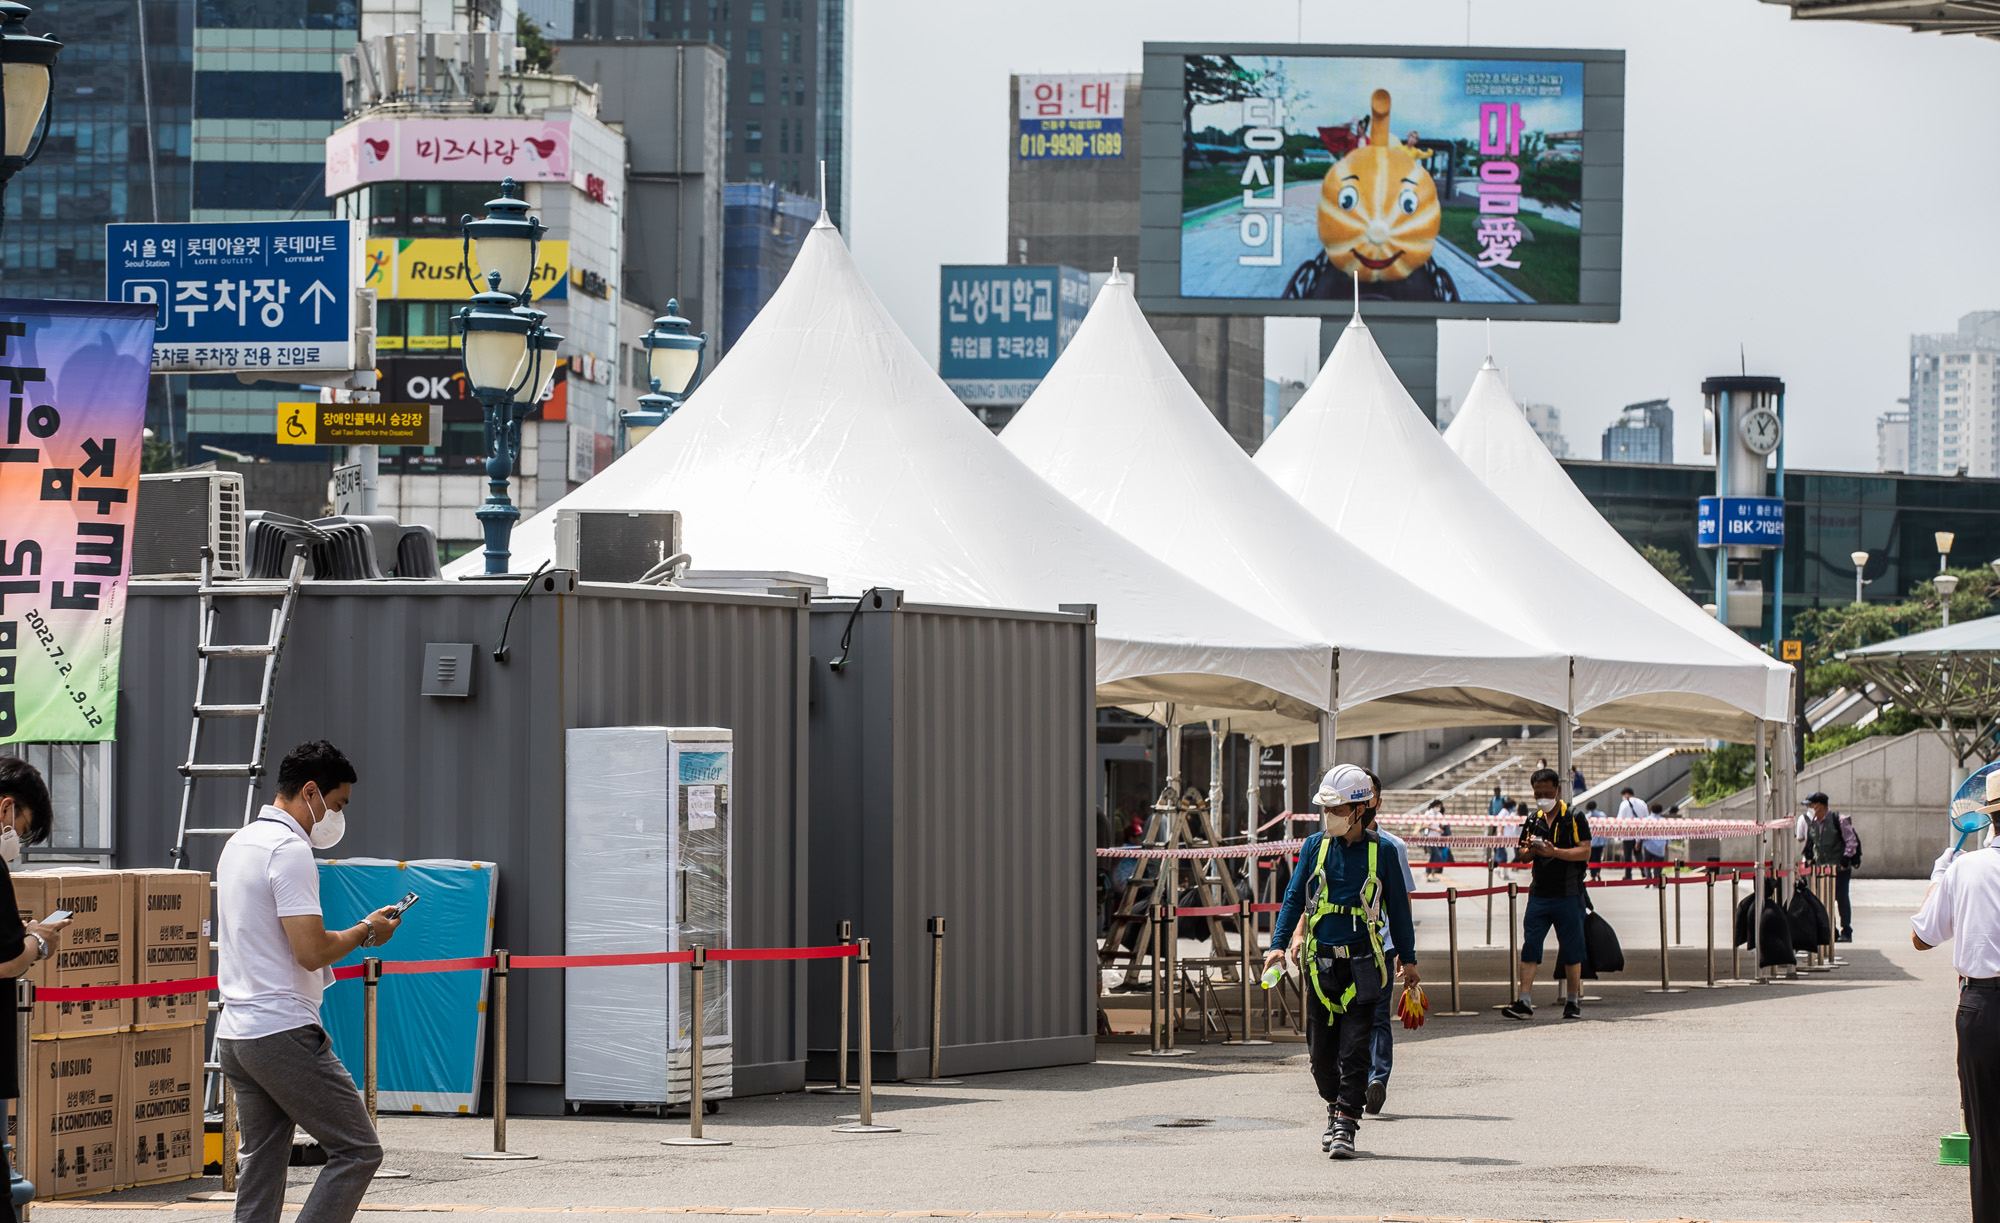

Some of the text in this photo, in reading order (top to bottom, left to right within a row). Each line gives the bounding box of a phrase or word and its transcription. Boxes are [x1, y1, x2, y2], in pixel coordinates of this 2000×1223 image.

[416, 136, 521, 166] 미즈사랑
[1020, 131, 1122, 157] 010-9930-1689
[1239, 97, 1289, 267] 당신의
[1476, 102, 1526, 270] 마음愛
[187, 237, 261, 256] 롯데아울렛
[273, 235, 337, 255] 롯데마트
[124, 259, 170, 268] Seoul Station
[410, 260, 472, 281] Rush
[174, 279, 291, 329] 주차장
[948, 277, 1054, 325] 신성대학교
[194, 347, 239, 367] 주차장
[244, 346, 272, 367] 전용
[277, 346, 320, 366] 진입로
[950, 335, 1049, 360] 취업률 전국2위
[322, 412, 423, 427] 장애인콜택시 승강장
[330, 428, 414, 437] Call Taxi Stand for the Disabled
[1728, 519, 1754, 534] IBK
[683, 761, 723, 781] Carrier
[56, 895, 98, 914] SAMSUNG
[147, 894, 182, 911] SAMSUNG
[72, 927, 83, 945] 삼성
[84, 926, 102, 944] 에어컨
[160, 925, 169, 941] 삼성
[169, 924, 184, 940] 에어컨
[69, 948, 119, 968] CONDITIONER
[157, 946, 198, 963] CONDITIONER
[134, 1046, 172, 1068] SAMSUNG
[50, 1057, 92, 1080] SAMSUNG
[148, 1079, 159, 1096] 삼성
[159, 1077, 175, 1093] 에어컨
[66, 1090, 78, 1108] 삼성
[79, 1088, 96, 1106] 에어컨
[146, 1097, 191, 1119] CONDITIONER
[64, 1109, 113, 1131] CONDITIONER
